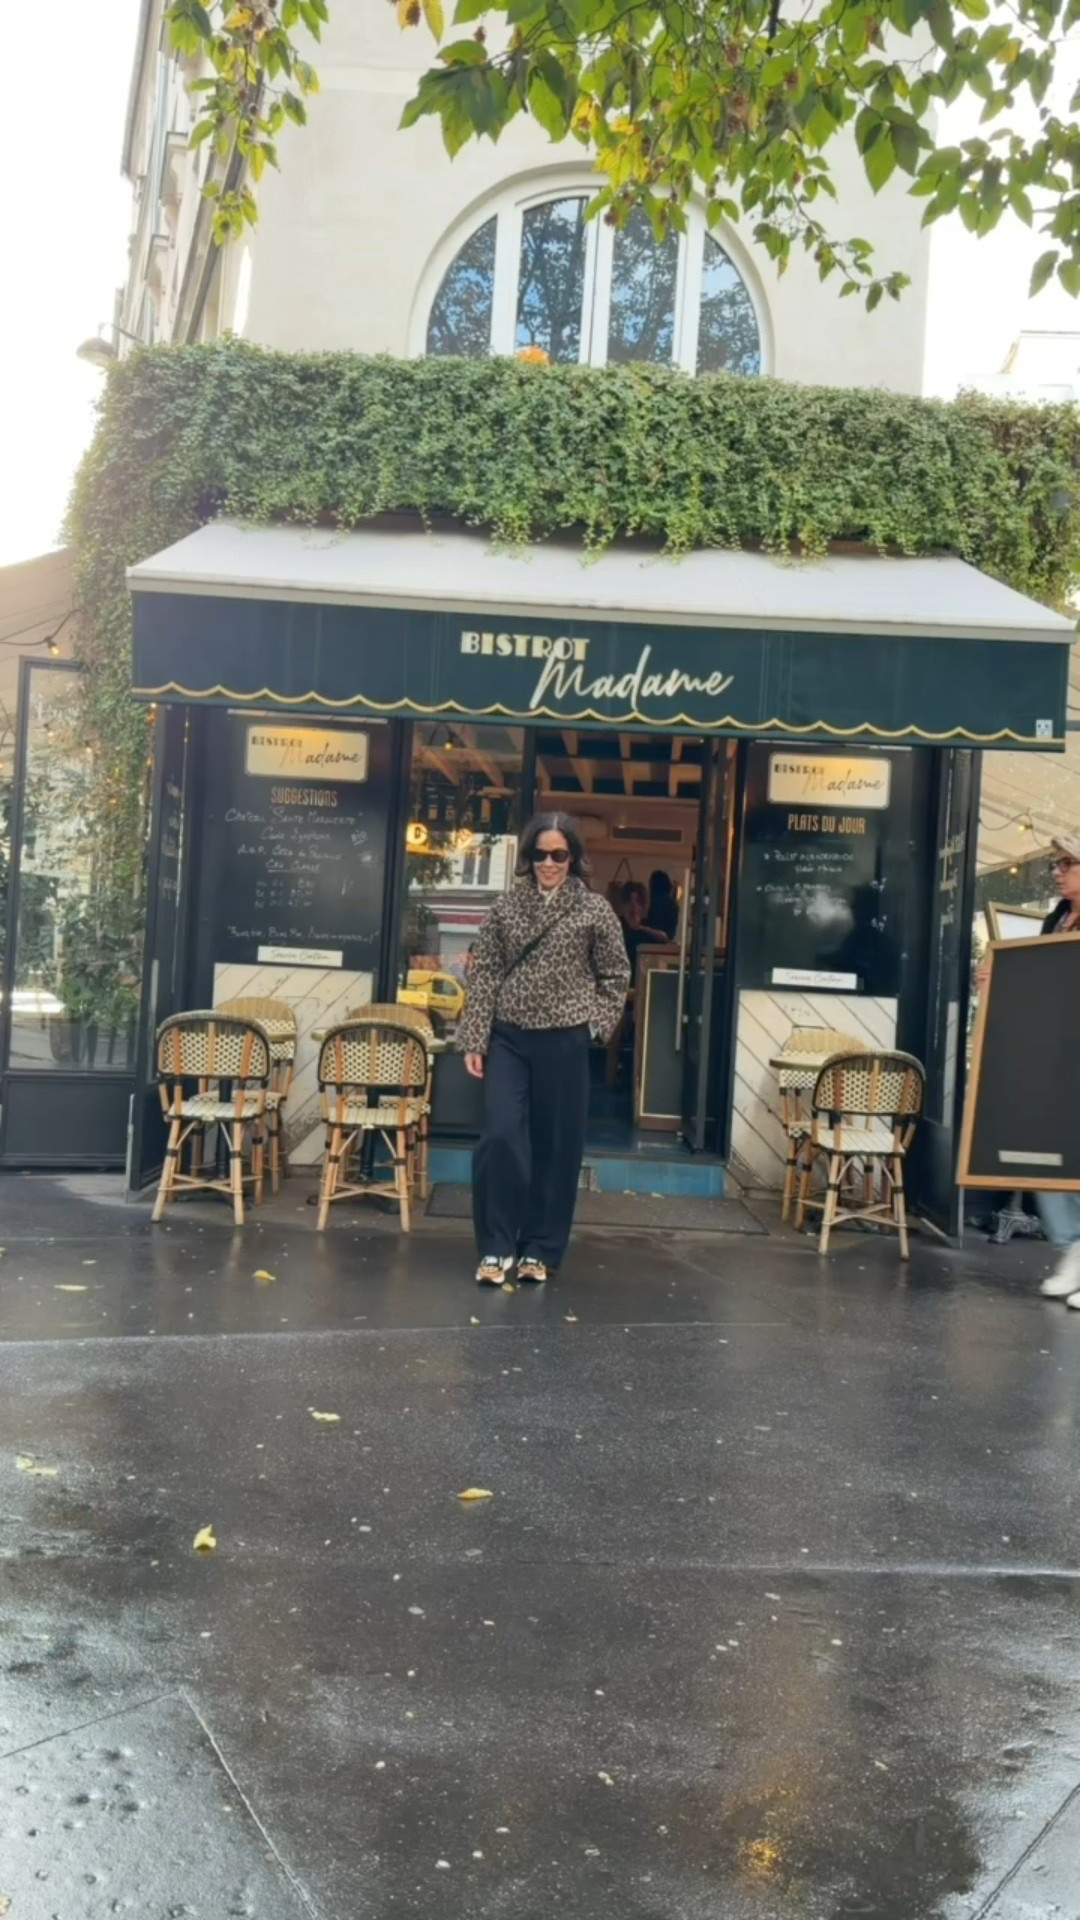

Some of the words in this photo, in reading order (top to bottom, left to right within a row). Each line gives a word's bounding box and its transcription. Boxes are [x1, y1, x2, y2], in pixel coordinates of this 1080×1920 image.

[460, 631, 590, 660] BISTROT
[529, 644, 734, 710] Madame
[279, 742, 363, 768] Madame
[802, 769, 883, 797] Madame
[271, 786, 338, 808] SUGGESTIONS
[788, 813, 818, 831] PLATS
[821, 815, 836, 832] DU
[838, 817, 867, 834] JOUR
